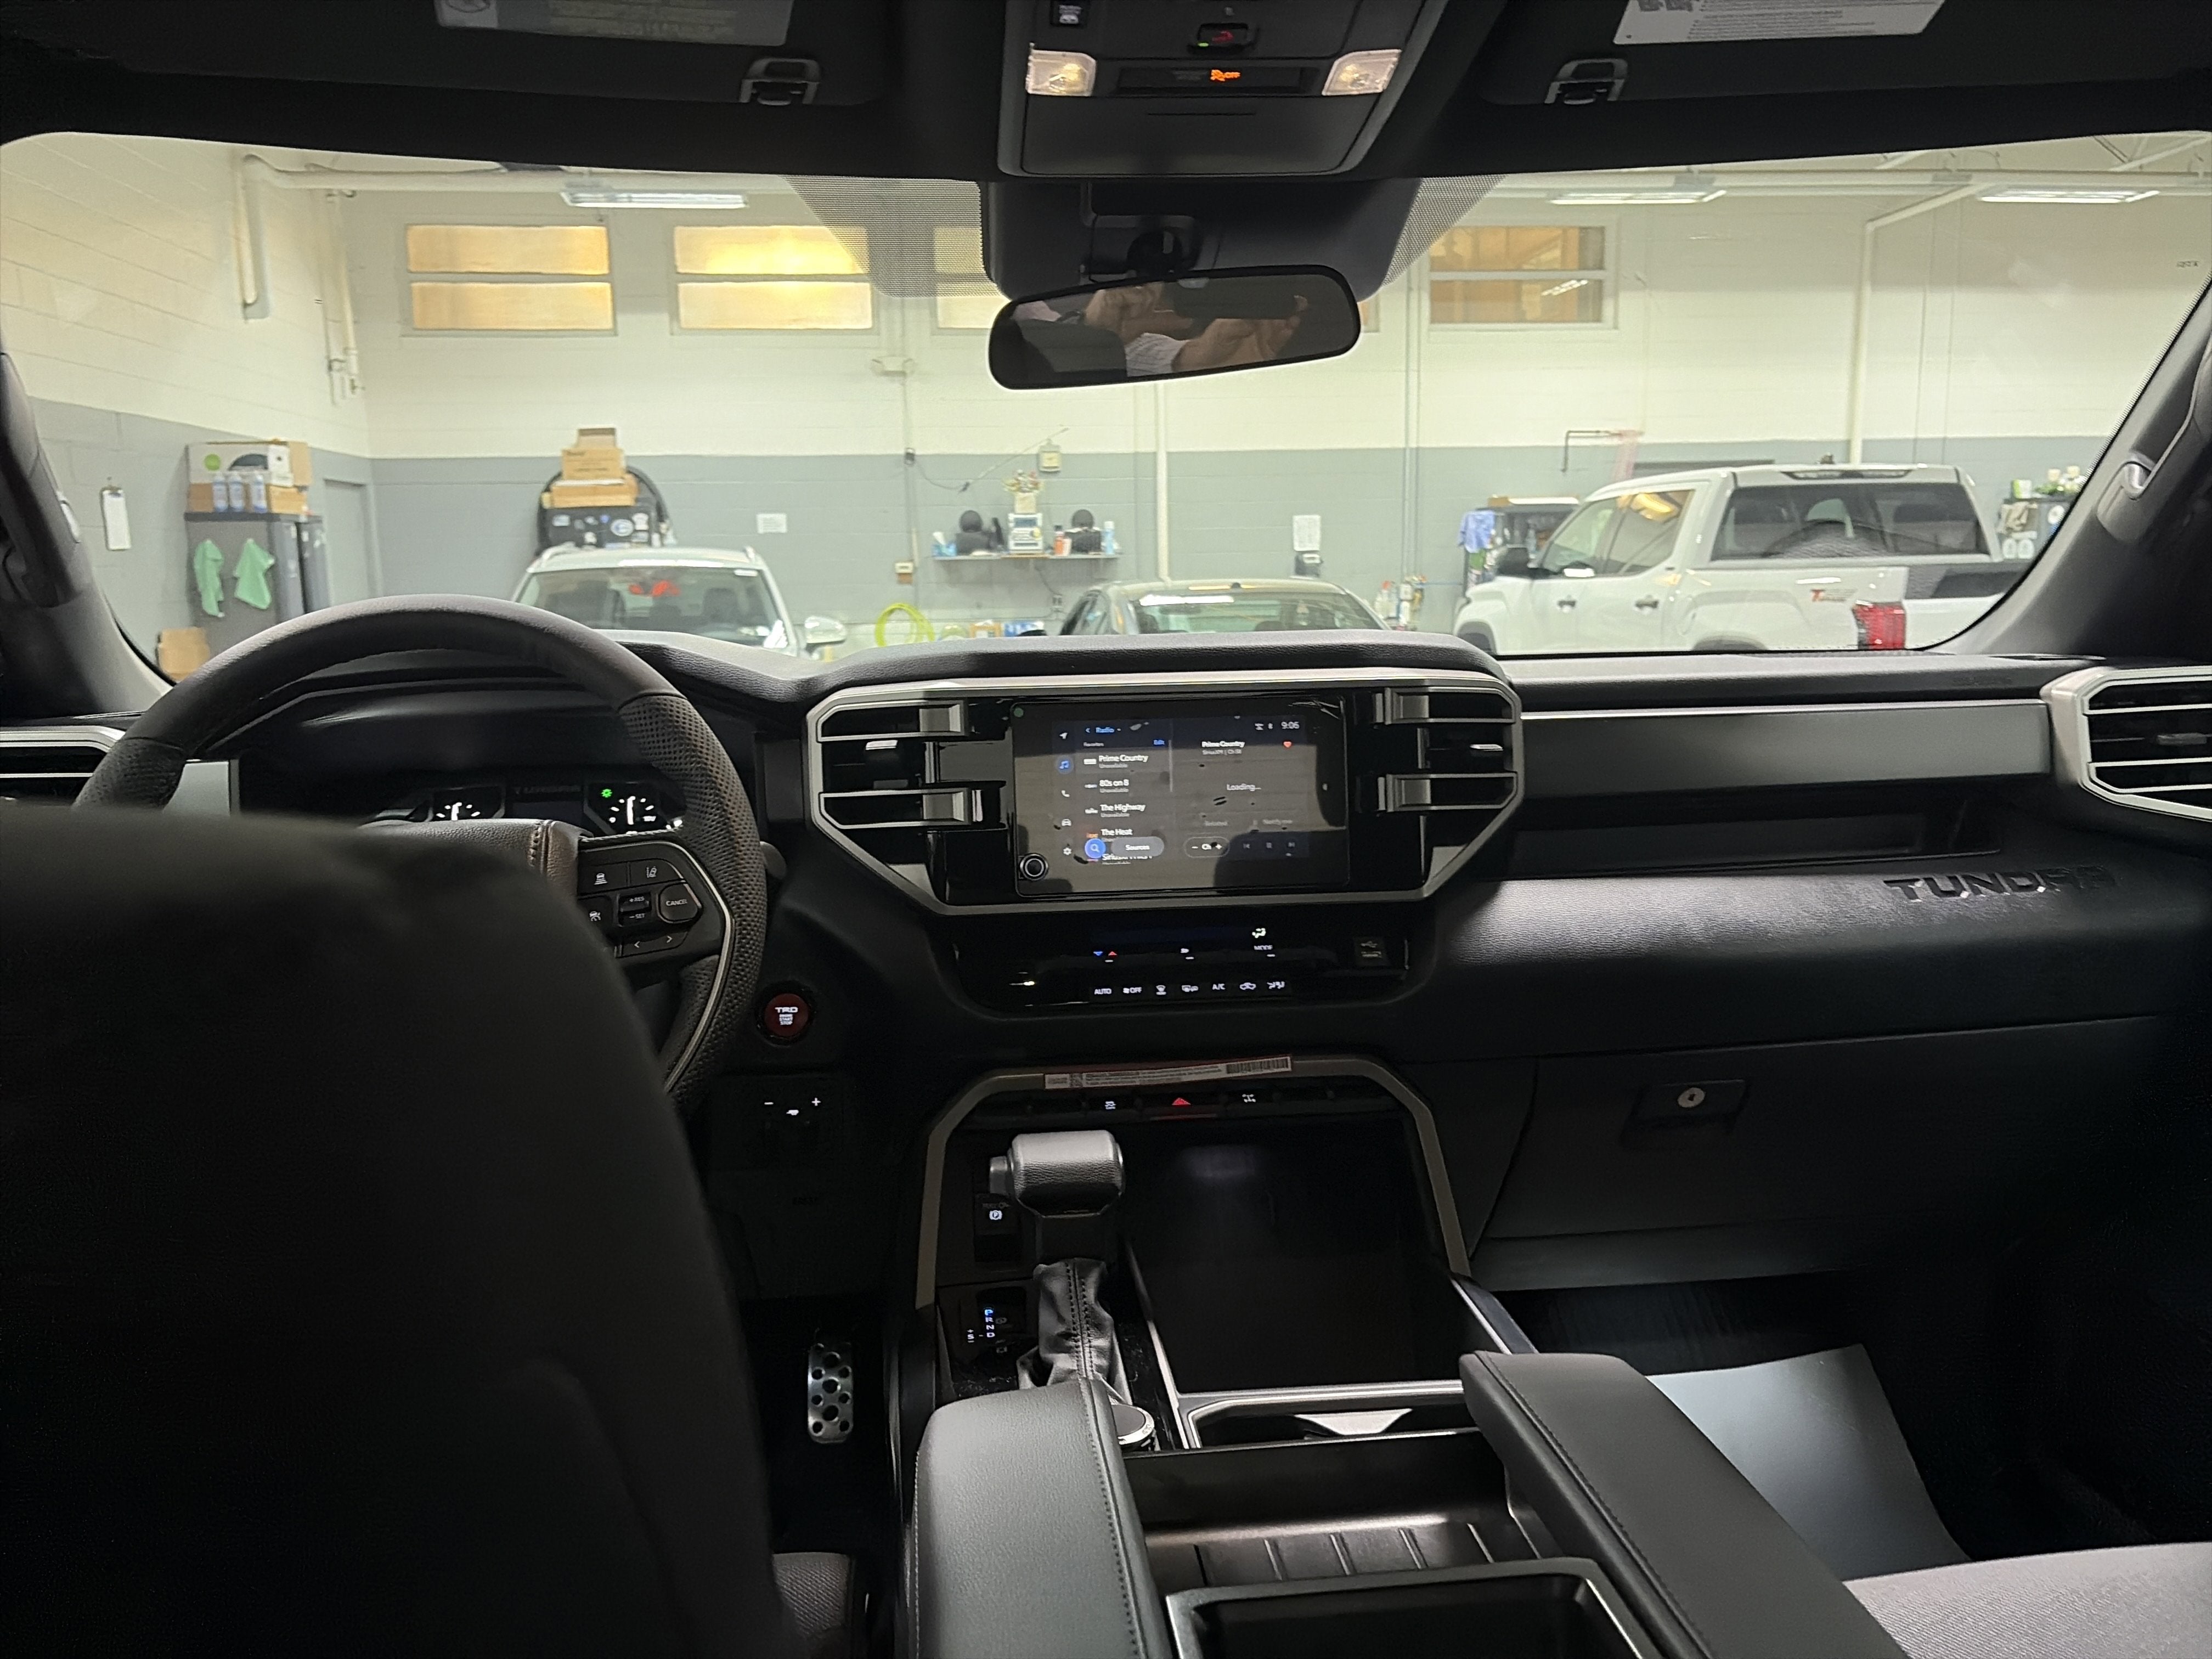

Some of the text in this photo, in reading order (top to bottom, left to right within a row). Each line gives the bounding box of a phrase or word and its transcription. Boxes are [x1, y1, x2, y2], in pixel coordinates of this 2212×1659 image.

[1120, 754, 1148, 763] Country
[1114, 804, 1146, 812] Highway
[1883, 866, 2117, 903] TUND
